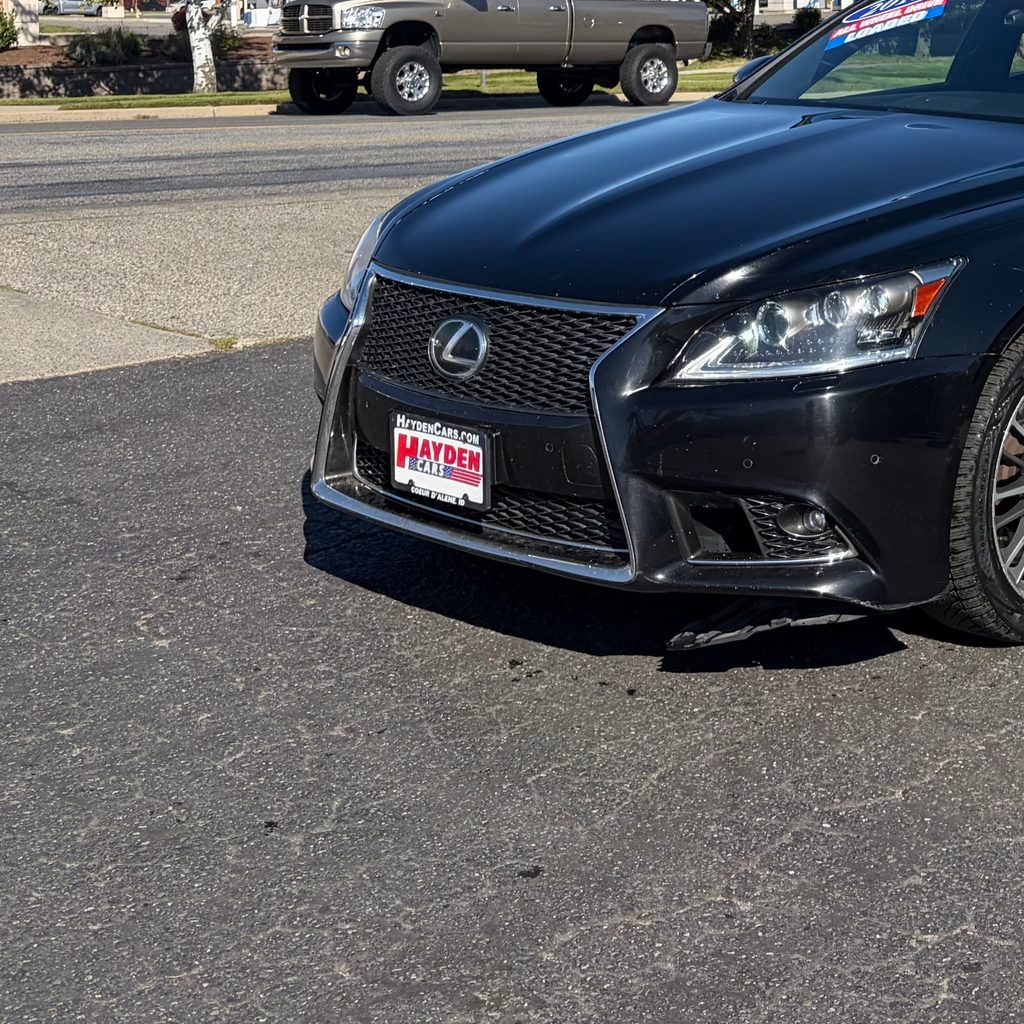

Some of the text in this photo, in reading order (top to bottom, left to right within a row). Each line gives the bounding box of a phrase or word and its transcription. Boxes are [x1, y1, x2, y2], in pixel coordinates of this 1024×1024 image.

[833, 23, 857, 38] ALL
[859, 9, 903, 29] WHEEL
[843, 10, 929, 43] LOADED
[396, 433, 481, 472] HAYDEN
[416, 459, 445, 477] CARS
